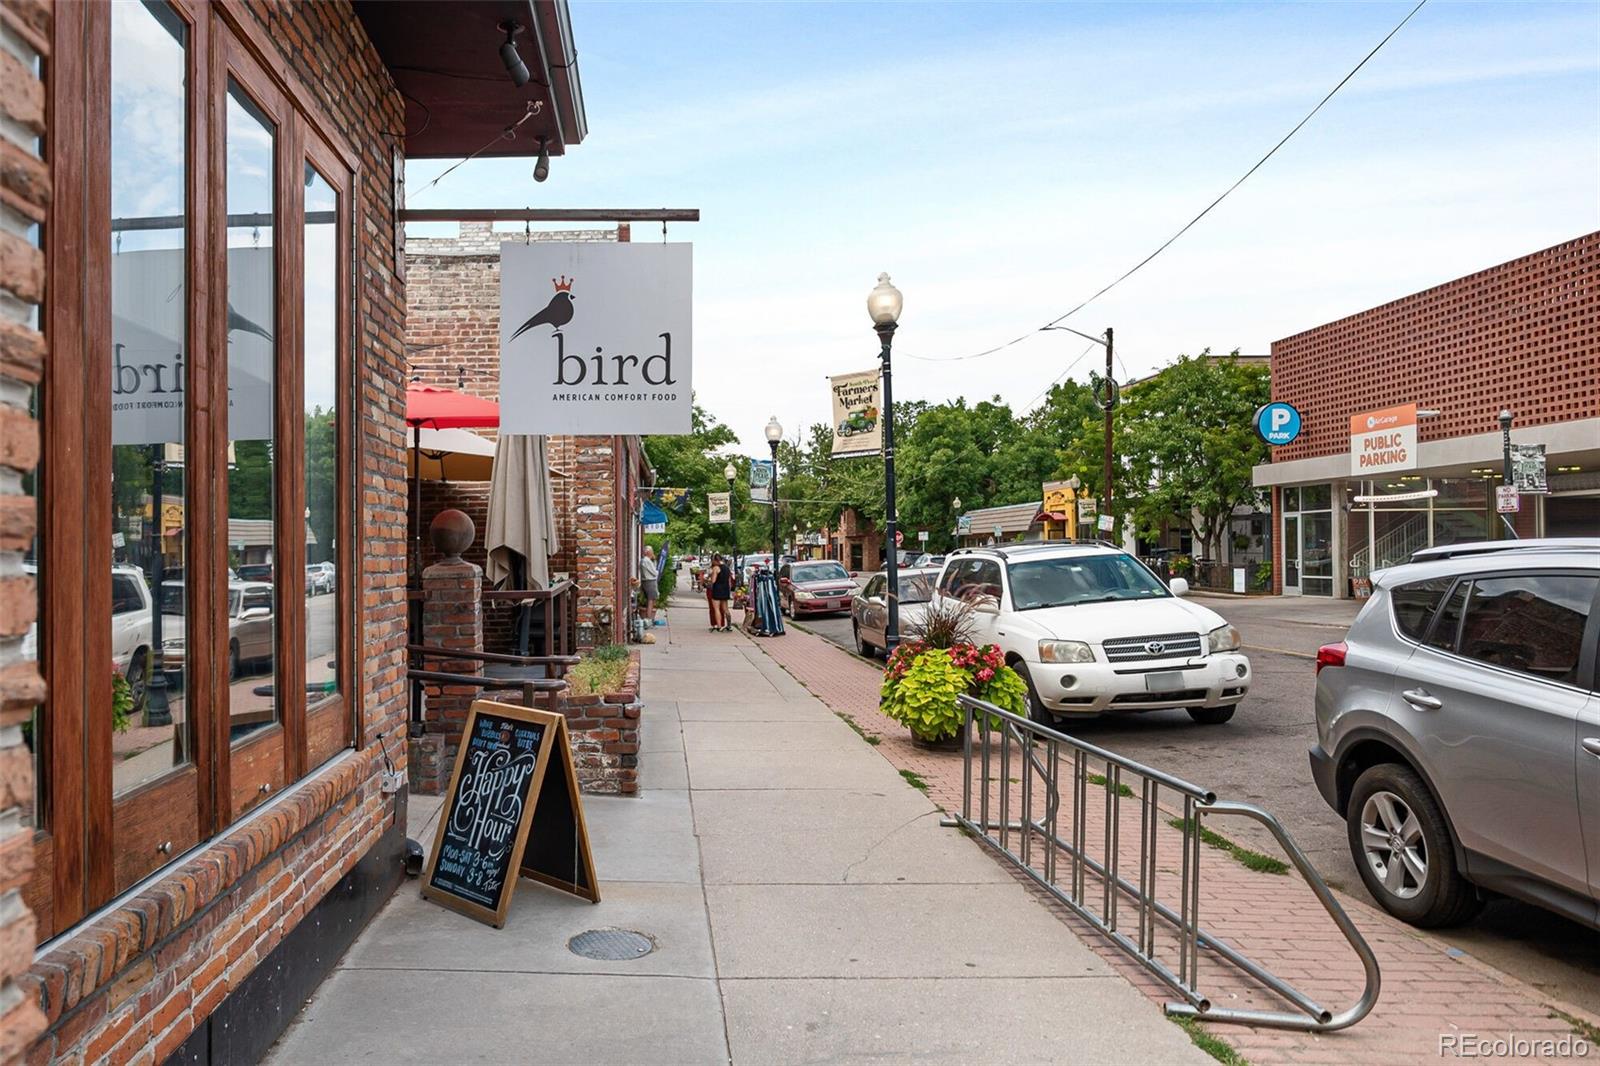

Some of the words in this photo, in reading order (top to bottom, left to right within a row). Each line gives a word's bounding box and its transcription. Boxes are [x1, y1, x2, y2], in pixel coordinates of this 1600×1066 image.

[552, 332, 677, 386] bird
[552, 393, 600, 401] AMERICAN
[604, 393, 648, 401] COMFORT
[652, 393, 678, 401] FOOD
[832, 382, 879, 397] Farmers
[839, 394, 873, 410] Market
[1271, 408, 1291, 432] P
[1268, 432, 1290, 440] PARK
[1364, 433, 1402, 451] PUBLIC
[1359, 449, 1407, 468] PARKING
[461, 749, 536, 812] Happy
[439, 858, 466, 877] SUNDAY
